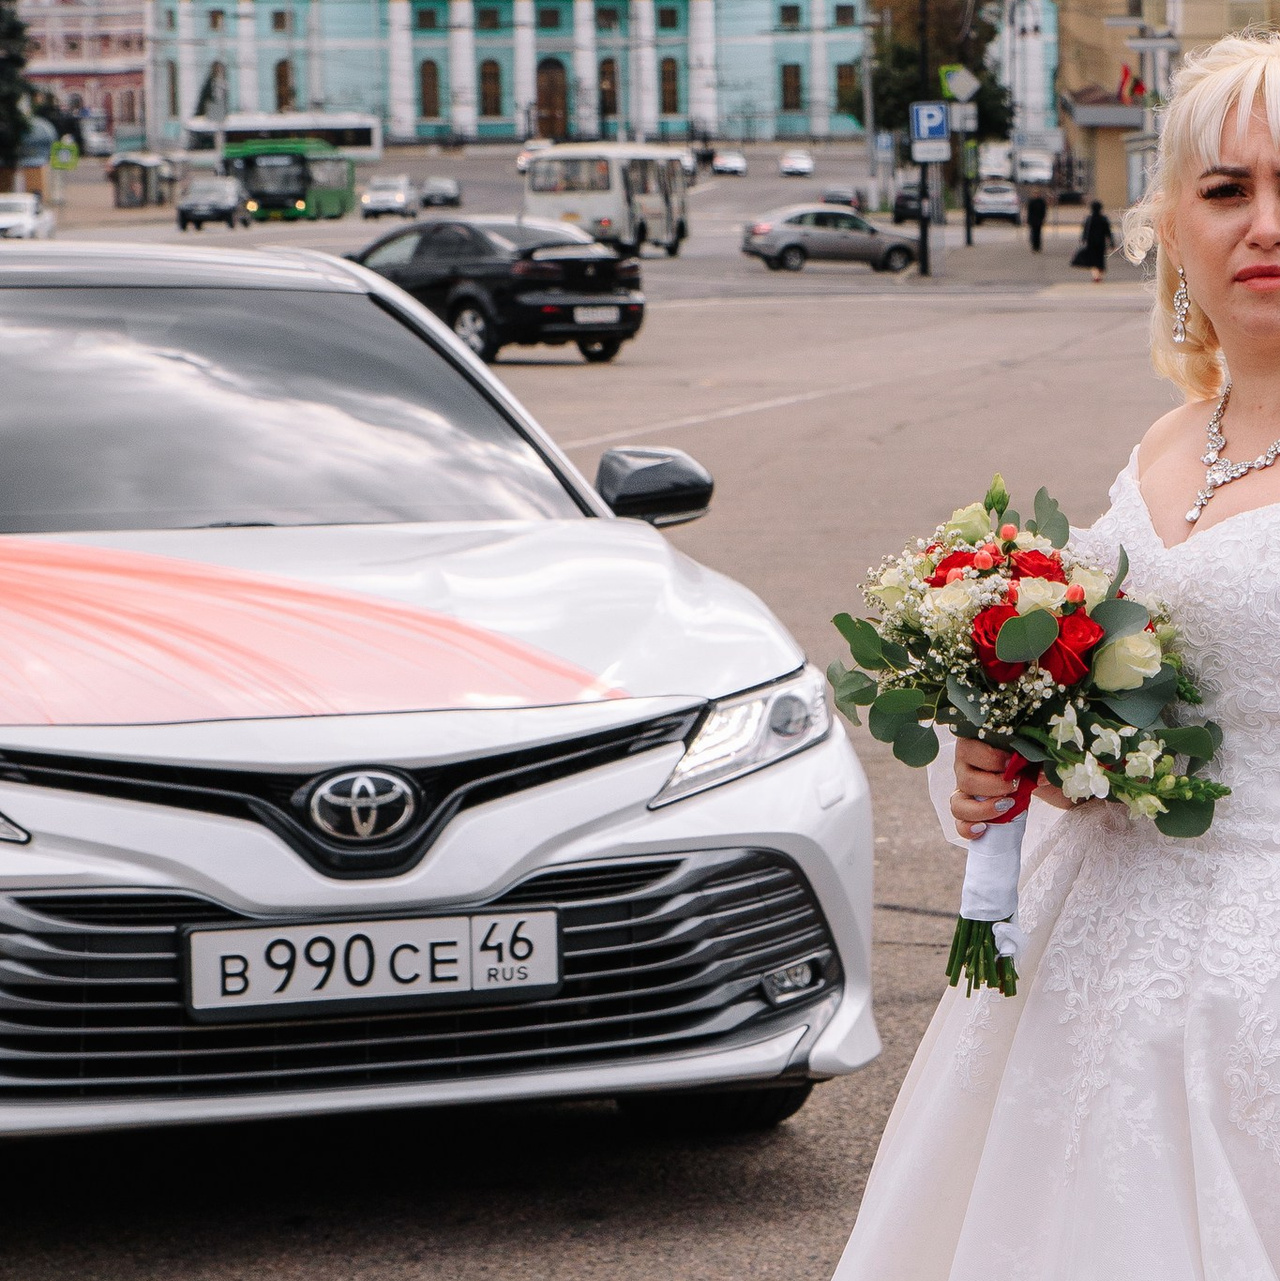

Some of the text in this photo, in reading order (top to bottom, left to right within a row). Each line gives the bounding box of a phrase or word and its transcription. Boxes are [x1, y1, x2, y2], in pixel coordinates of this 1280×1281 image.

[918, 106, 943, 138] P
[479, 920, 534, 963] 46
[486, 966, 529, 983] RUS
